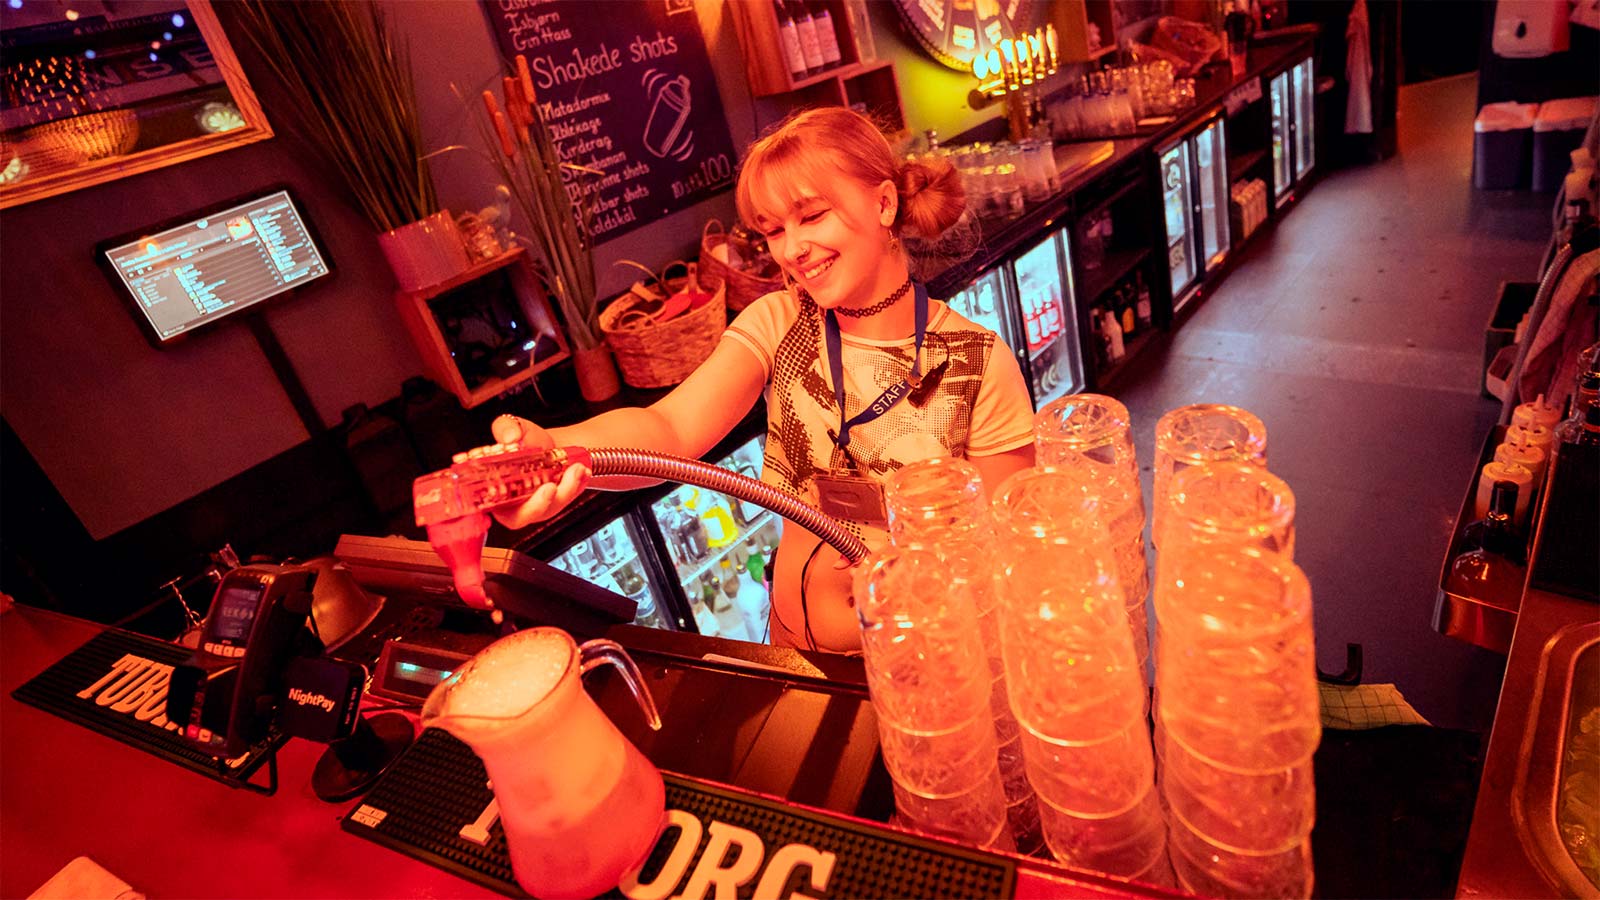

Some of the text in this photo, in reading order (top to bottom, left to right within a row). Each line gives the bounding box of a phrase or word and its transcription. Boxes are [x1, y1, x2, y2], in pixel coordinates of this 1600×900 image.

[513, 31, 541, 51] Gin
[532, 31, 678, 89] Shakede shots
[623, 161, 650, 180] shots
[623, 184, 650, 203] shots
[76, 653, 184, 737] TUBO
[288, 687, 336, 713] NightPay
